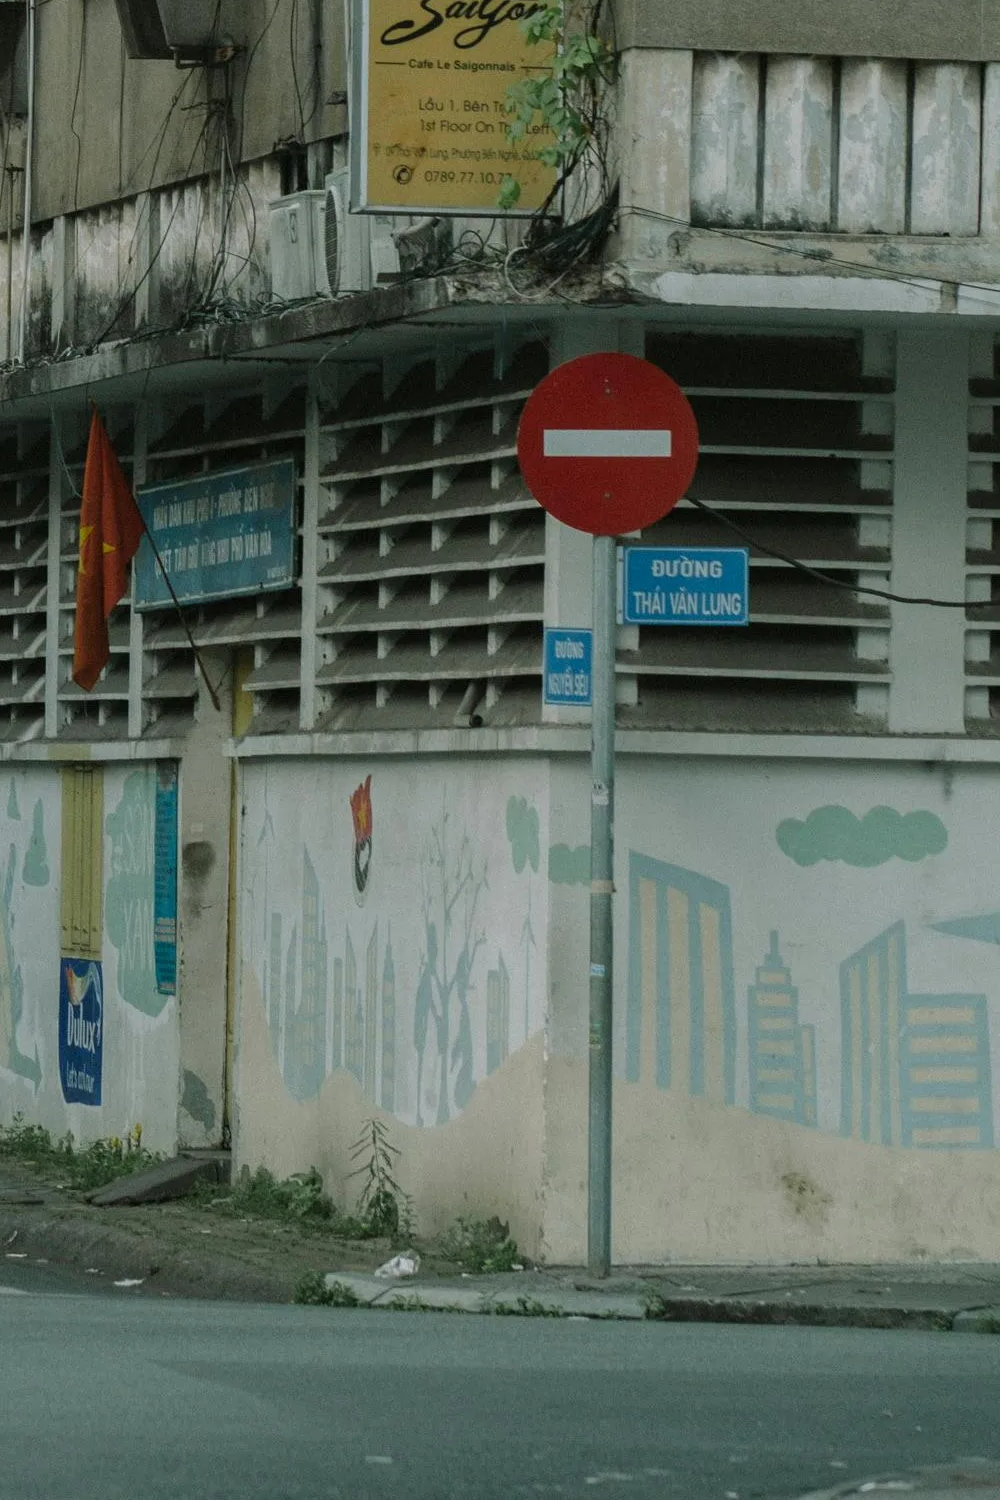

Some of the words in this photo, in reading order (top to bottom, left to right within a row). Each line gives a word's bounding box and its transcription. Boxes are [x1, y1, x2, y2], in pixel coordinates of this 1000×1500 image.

[408, 58, 434, 69] Cafe
[437, 60, 451, 70] Le
[454, 60, 516, 73] Saigonnais
[420, 119, 436, 132] 1st
[440, 119, 473, 133] Floor
[475, 120, 495, 133] On
[526, 124, 551, 135] Left
[651, 554, 723, 579] ĐƯỜNG
[634, 586, 665, 615] THÁI
[670, 585, 698, 616] VĂN
[702, 592, 741, 616] LUNG
[67, 1001, 96, 1054] Dulux
